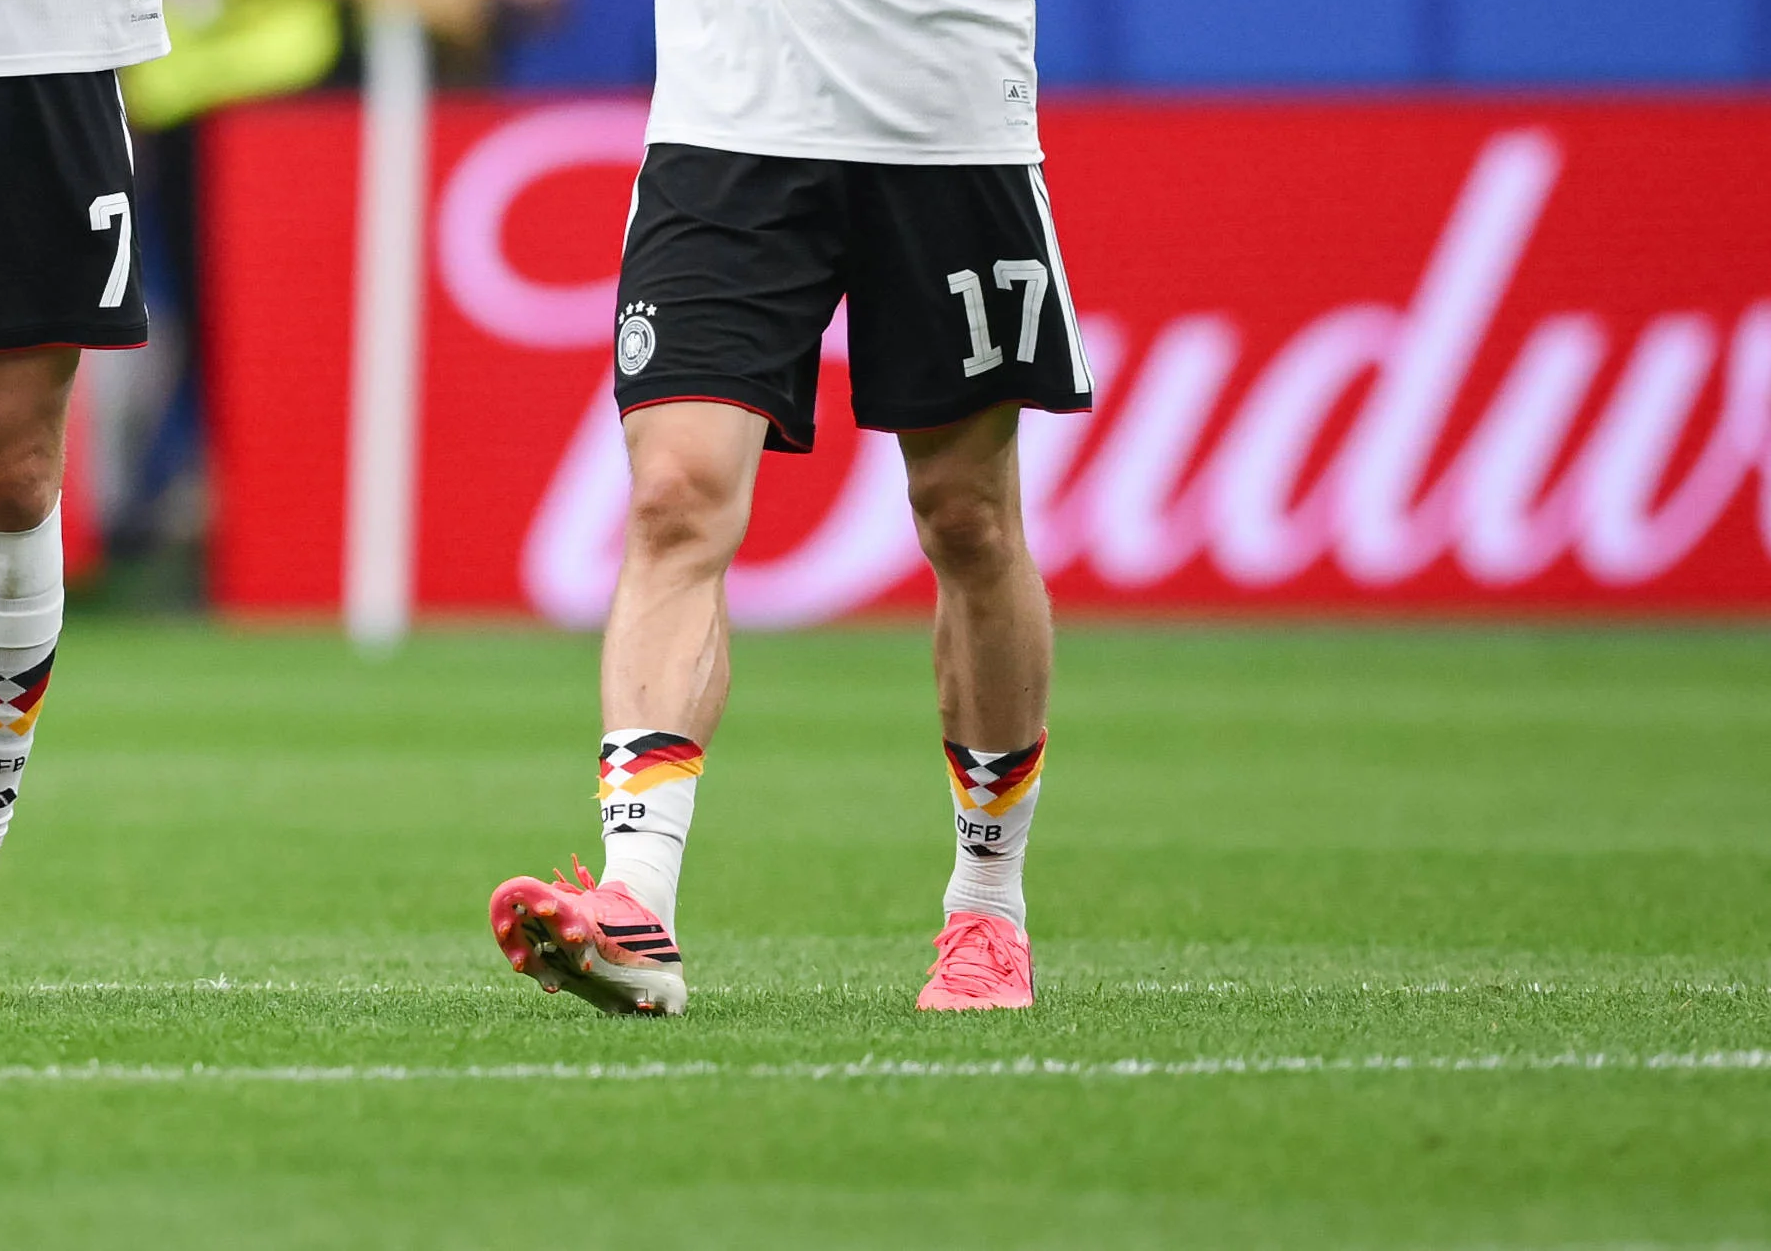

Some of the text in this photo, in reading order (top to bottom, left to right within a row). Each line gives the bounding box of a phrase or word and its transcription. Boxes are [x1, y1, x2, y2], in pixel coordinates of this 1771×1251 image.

[88, 191, 131, 308] 7
[947, 259, 1048, 378] 17
[957, 813, 1002, 842] DFB
